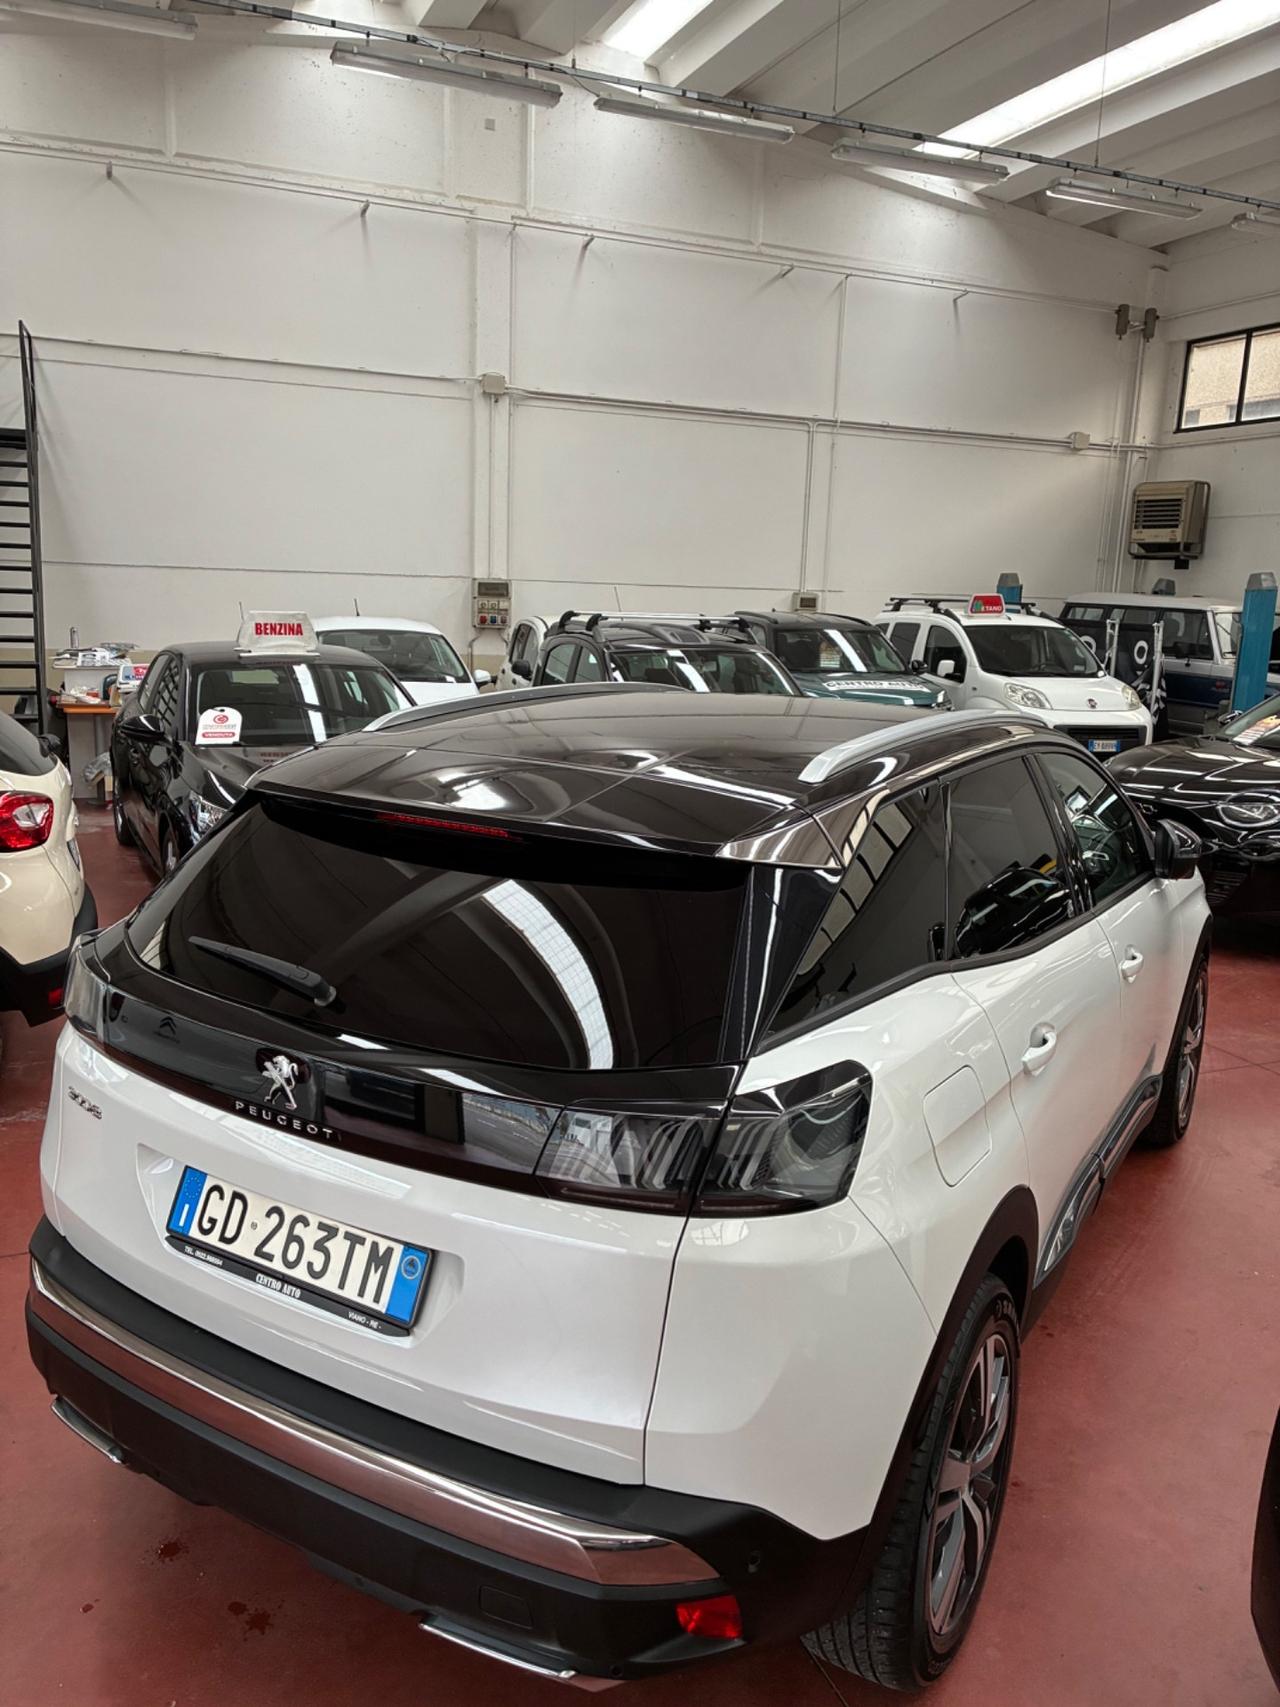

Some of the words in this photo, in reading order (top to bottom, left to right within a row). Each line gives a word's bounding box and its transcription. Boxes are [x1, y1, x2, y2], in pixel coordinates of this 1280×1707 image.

[254, 622, 304, 636] BENZINA
[235, 1101, 333, 1139] PEUGEOT
[197, 1184, 249, 1246] GD
[253, 1204, 395, 1305] 263TM
[255, 1273, 281, 1291] CENTRO
[281, 1282, 302, 1299] AUTO
